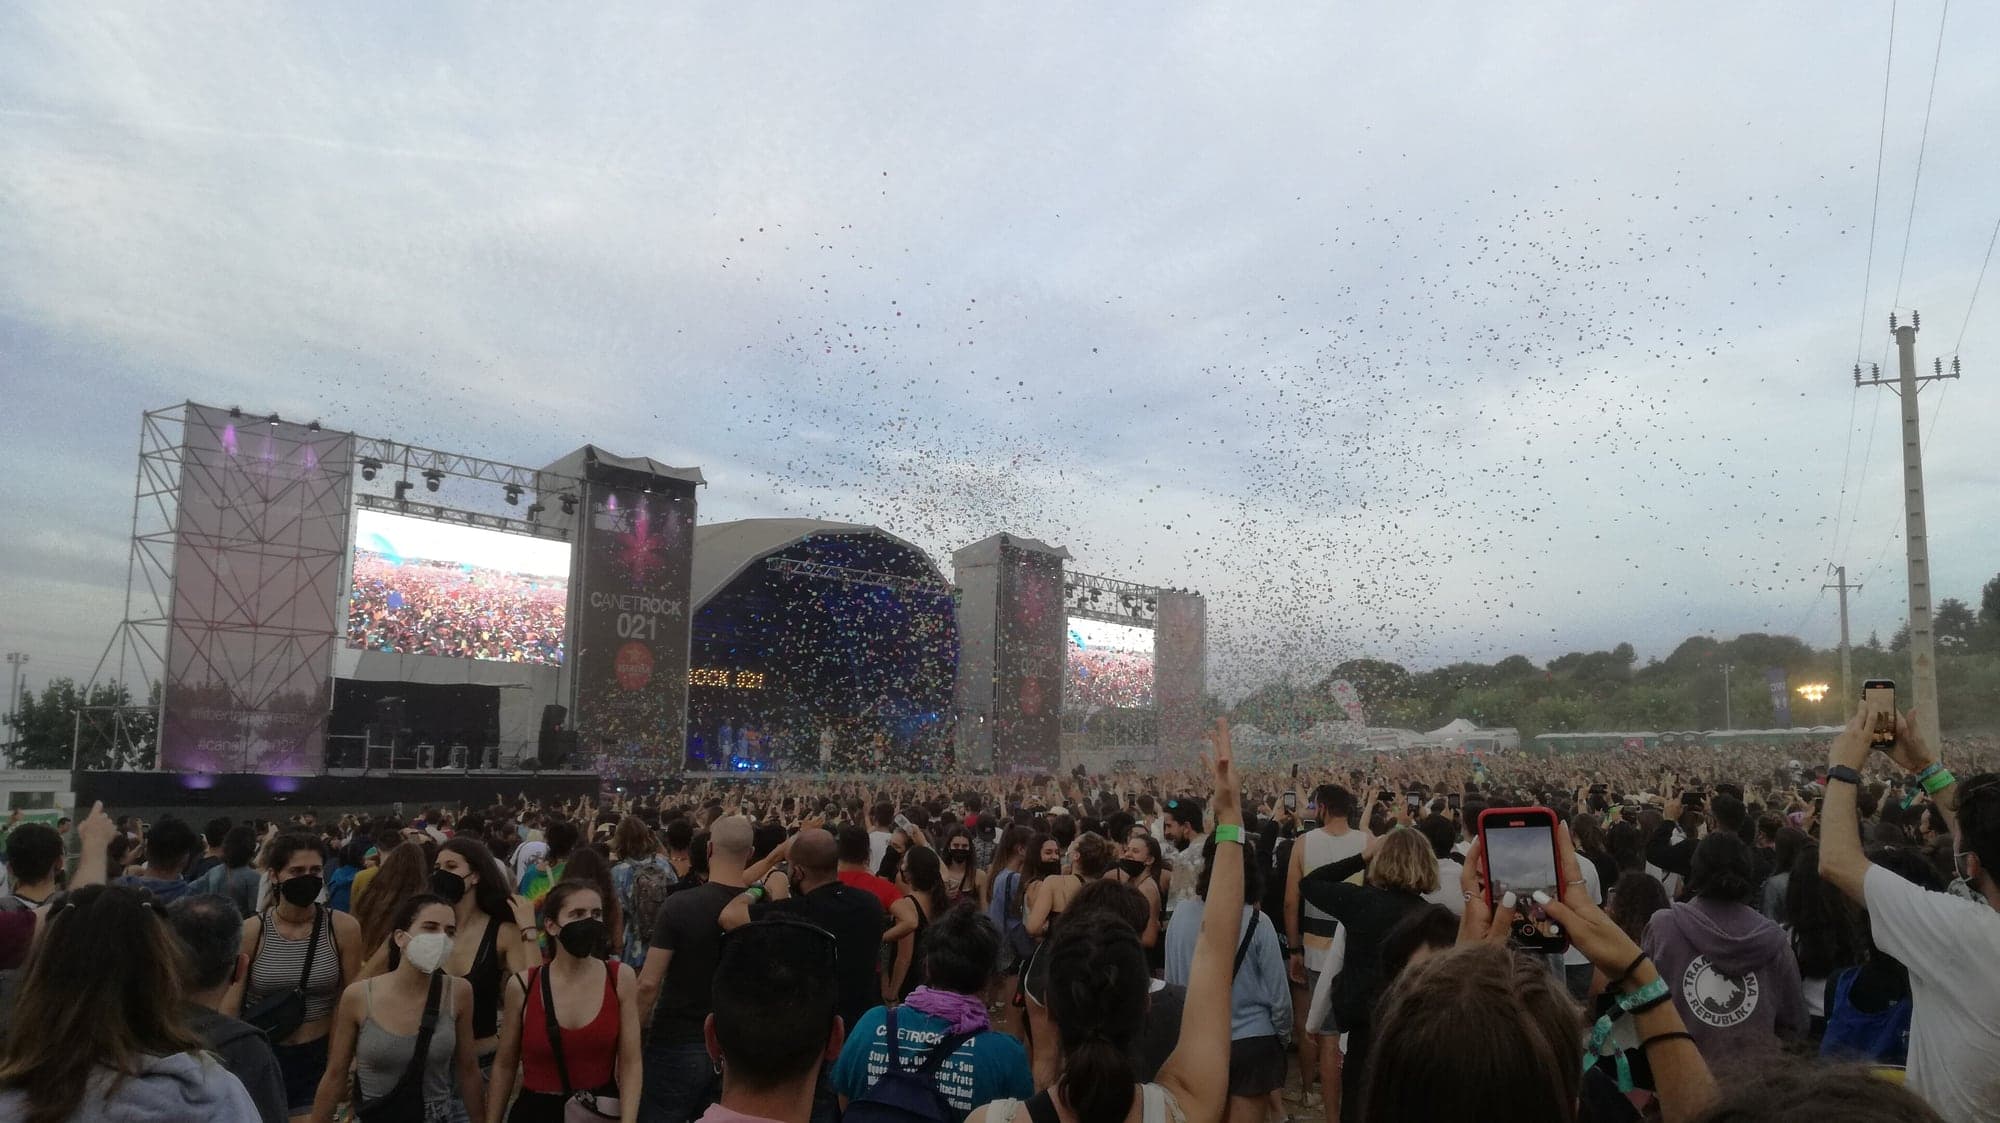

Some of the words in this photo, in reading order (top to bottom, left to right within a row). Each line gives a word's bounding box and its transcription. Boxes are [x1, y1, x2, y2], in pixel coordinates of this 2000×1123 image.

[590, 591, 683, 616] CANETROCK
[617, 613, 657, 640] 021
[736, 671, 763, 688] 021
[1690, 998, 1749, 1025] REPUBLIK
[876, 1025, 944, 1046] CETROCK
[952, 1071, 974, 1086] Prats
